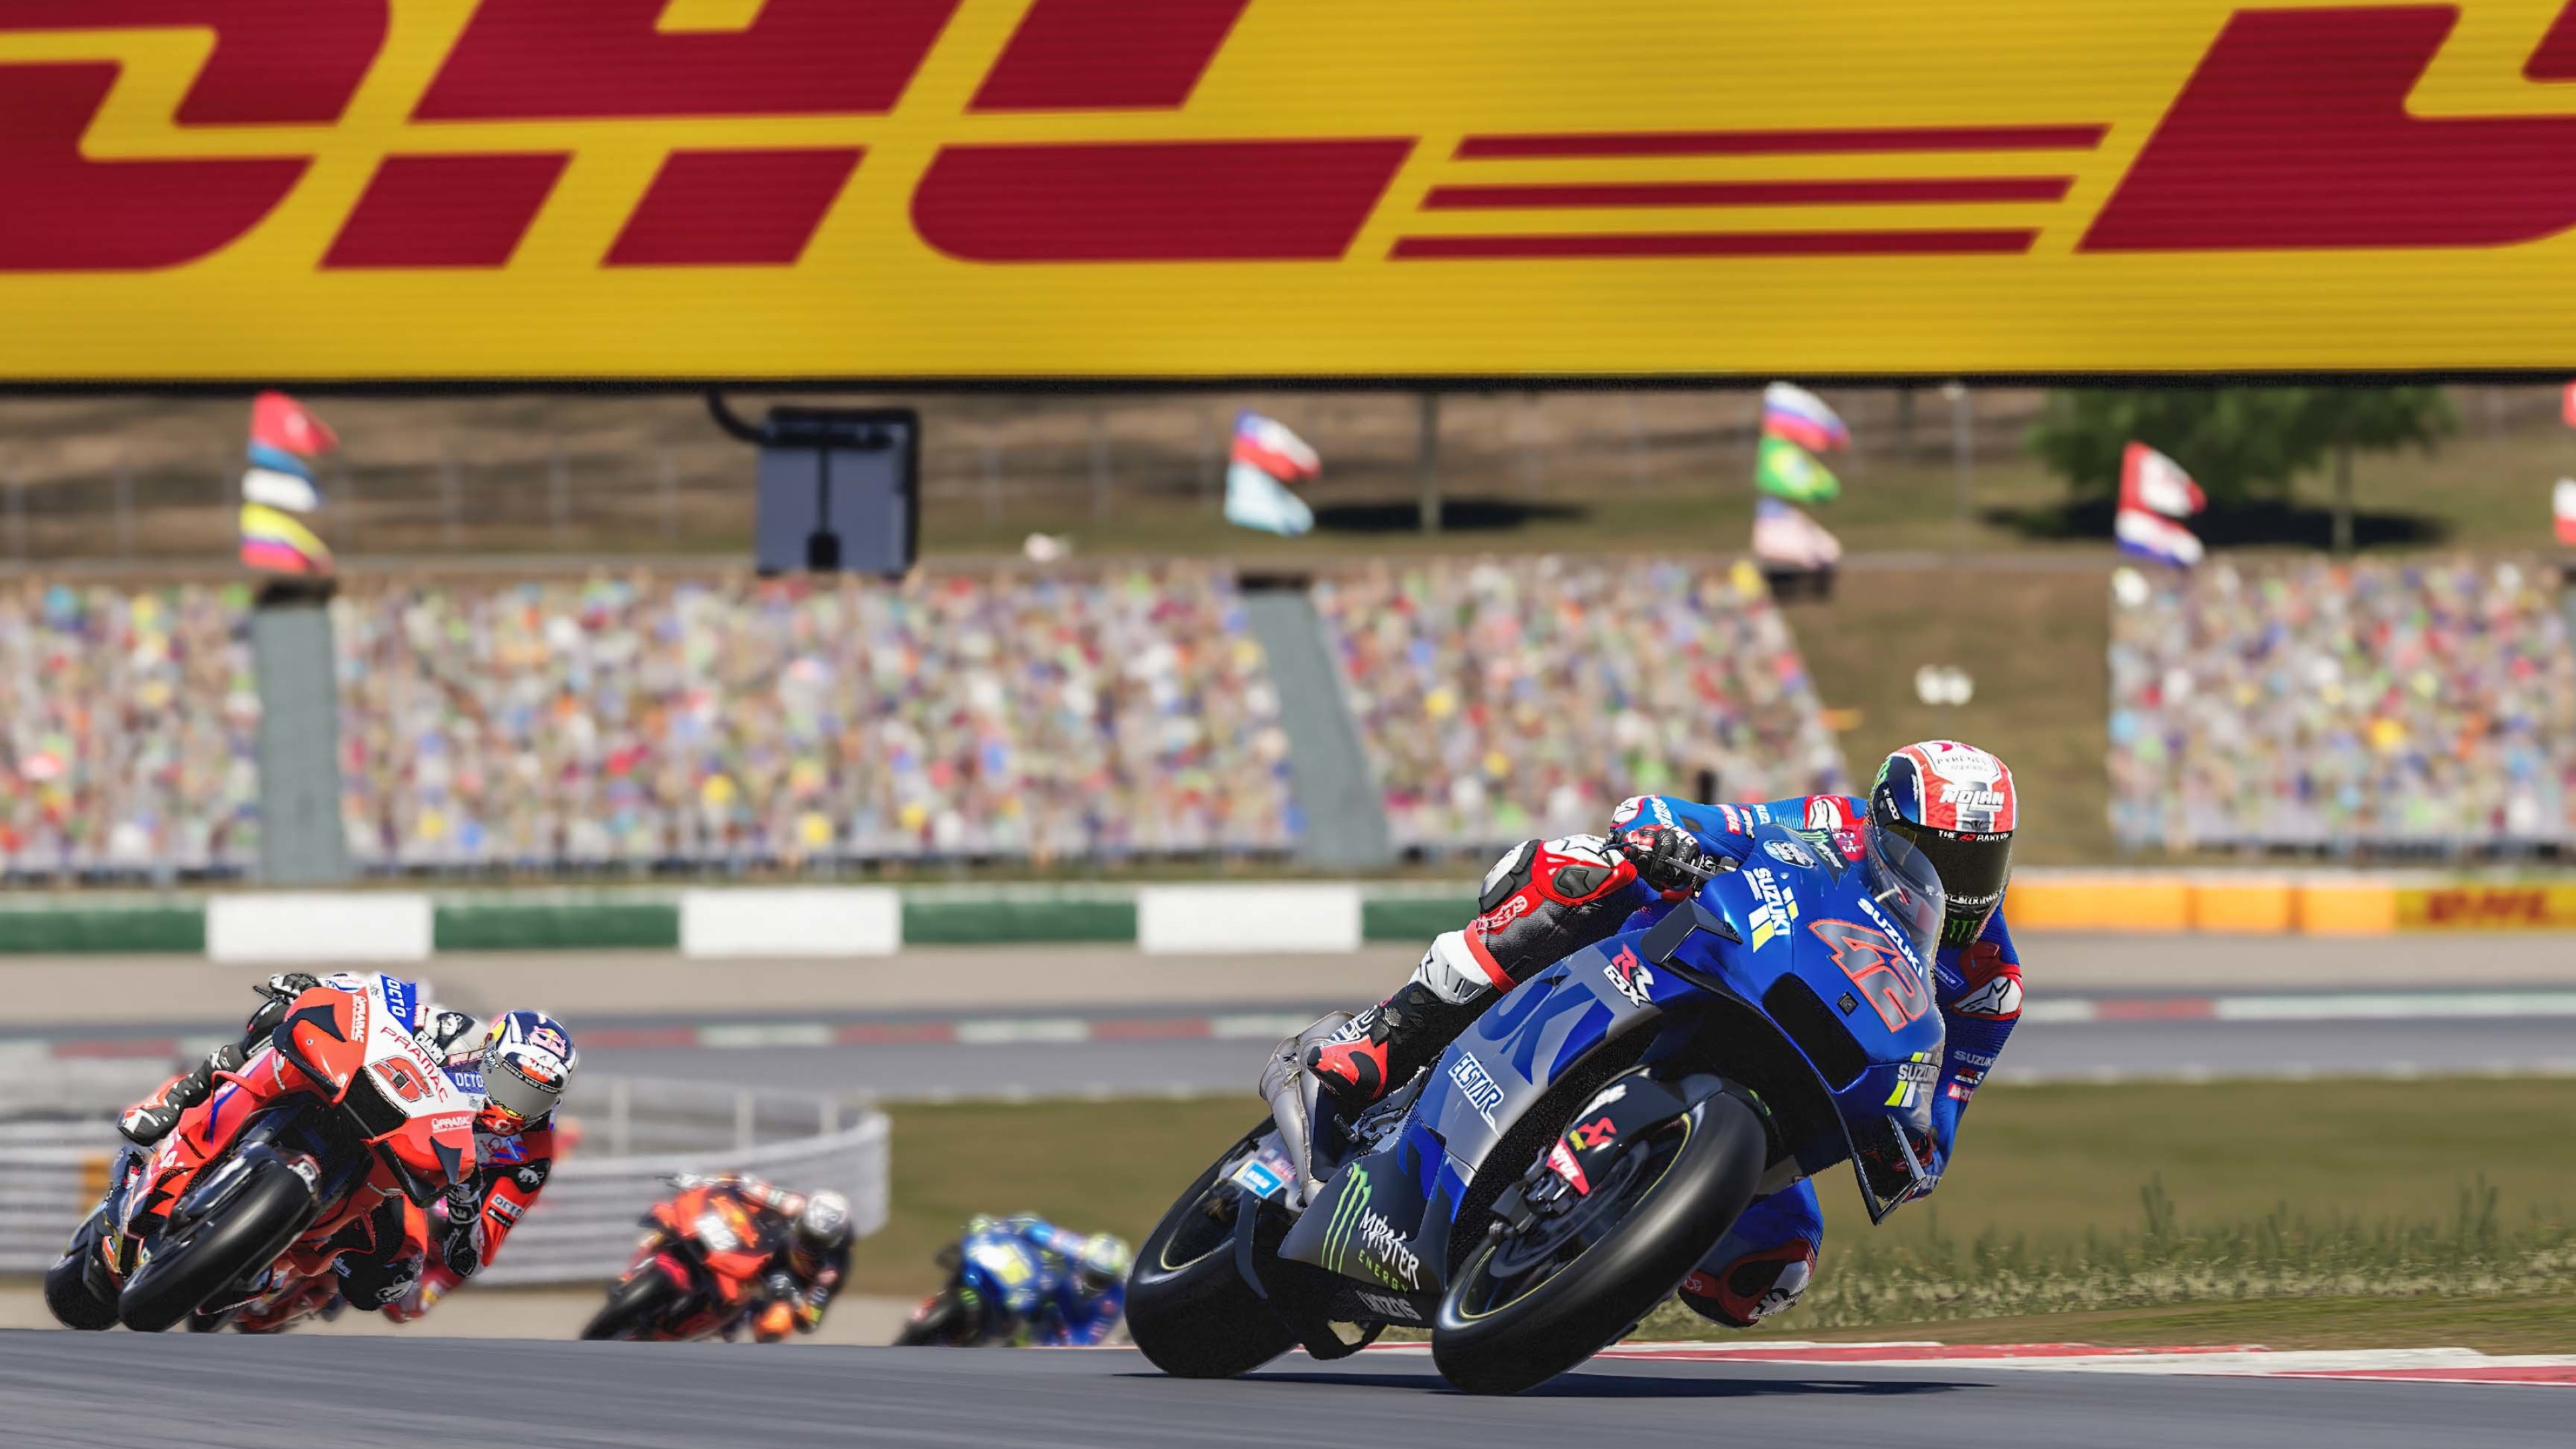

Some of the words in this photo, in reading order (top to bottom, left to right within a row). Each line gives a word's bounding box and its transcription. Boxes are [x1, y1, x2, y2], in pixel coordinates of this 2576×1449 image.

[1752, 867, 1792, 934] SUZUKI
[1857, 898, 1923, 979] SUZUKI
[386, 978, 407, 1018] OCTO
[1807, 918, 1930, 1034] 42
[380, 1026, 449, 1104] PRAMAC
[454, 1072, 484, 1089] OCTO
[1448, 1051, 1504, 1119] ECSTAR
[1953, 1051, 1996, 1067] SUZUK
[1358, 1248, 1409, 1295] ENERGY
